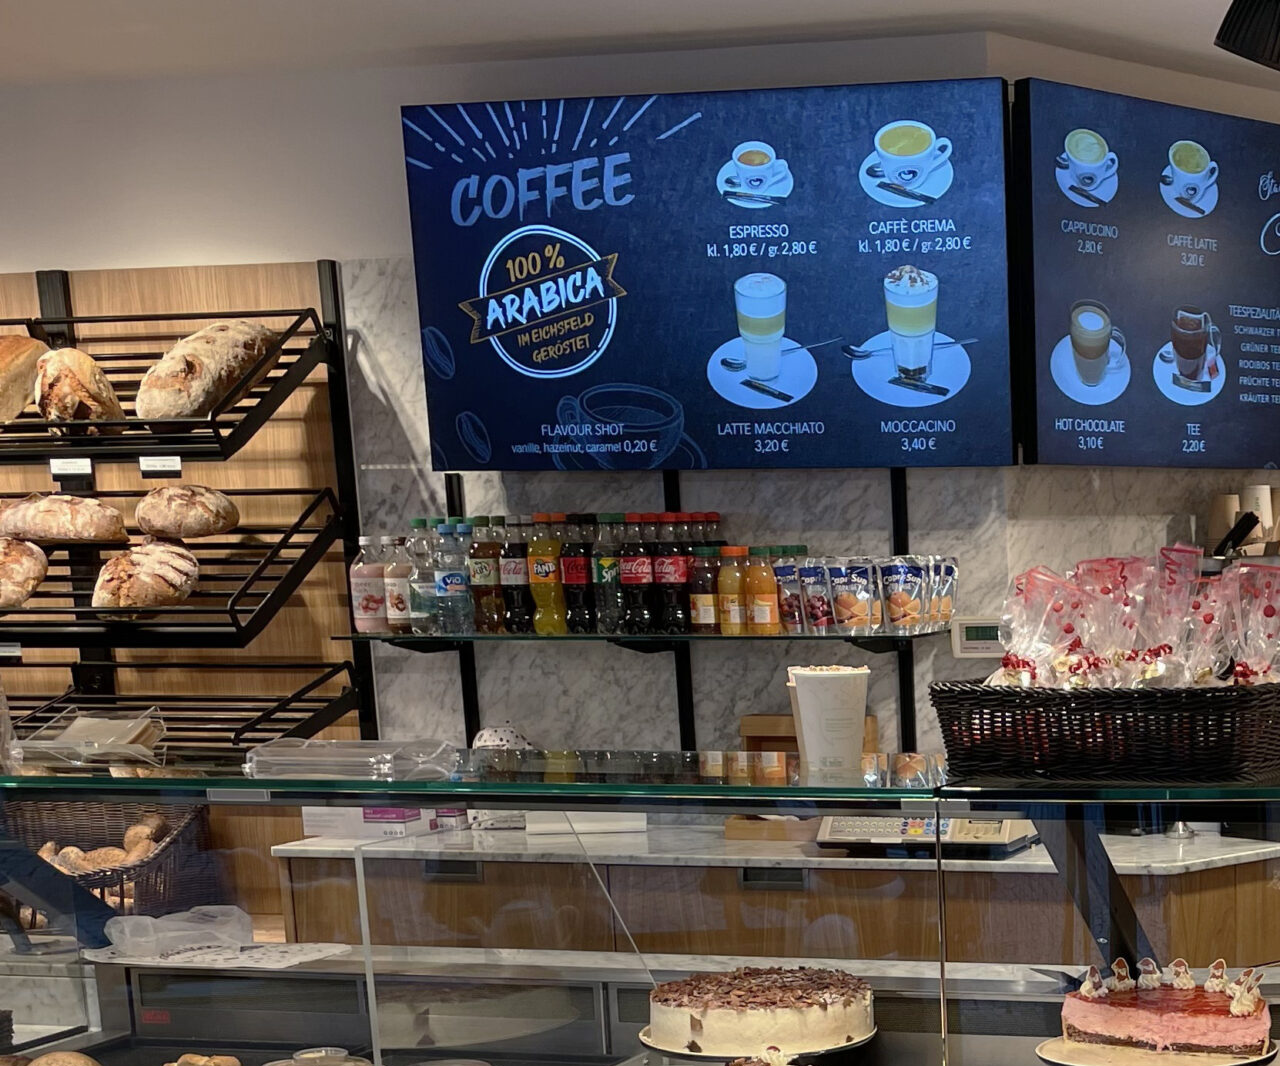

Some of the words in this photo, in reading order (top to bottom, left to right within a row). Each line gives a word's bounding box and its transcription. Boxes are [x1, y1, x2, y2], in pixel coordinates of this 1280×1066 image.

[451, 152, 636, 227] COFFEE
[729, 224, 789, 239] ESPRESSO
[869, 217, 908, 235] CAFFÈ
[911, 219, 956, 234] CREMA
[1061, 219, 1119, 239] CAPPUCCINO
[707, 243, 720, 257] kl.
[723, 243, 748, 259] 1,80
[781, 241, 807, 257] 2,80
[858, 239, 872, 253] kl.
[875, 238, 900, 255] 1,80
[935, 236, 961, 253] 2,80
[1167, 233, 1193, 249] CAFFÈ
[1194, 237, 1218, 252] LATTE
[506, 251, 542, 283] 100
[544, 243, 565, 269] %
[486, 266, 605, 330] ARABICA
[517, 332, 531, 348] IM
[531, 312, 595, 343] EICHSFELD
[1234, 325, 1275, 337] SCHWARZER
[532, 333, 590, 364] GERÖSTET
[1239, 359, 1271, 371] ROOIBOS
[541, 423, 593, 437] FLAVOUR
[595, 423, 625, 436] SHOT
[717, 422, 752, 436] LATTE
[754, 421, 825, 435] MACCHIATO
[880, 419, 956, 433] MOCCACINO
[1055, 418, 1072, 431] HOT
[1074, 419, 1126, 433] CHOCOLATE
[1186, 423, 1201, 436] TEE
[754, 439, 779, 454] 3,20
[901, 437, 927, 452] 3,40
